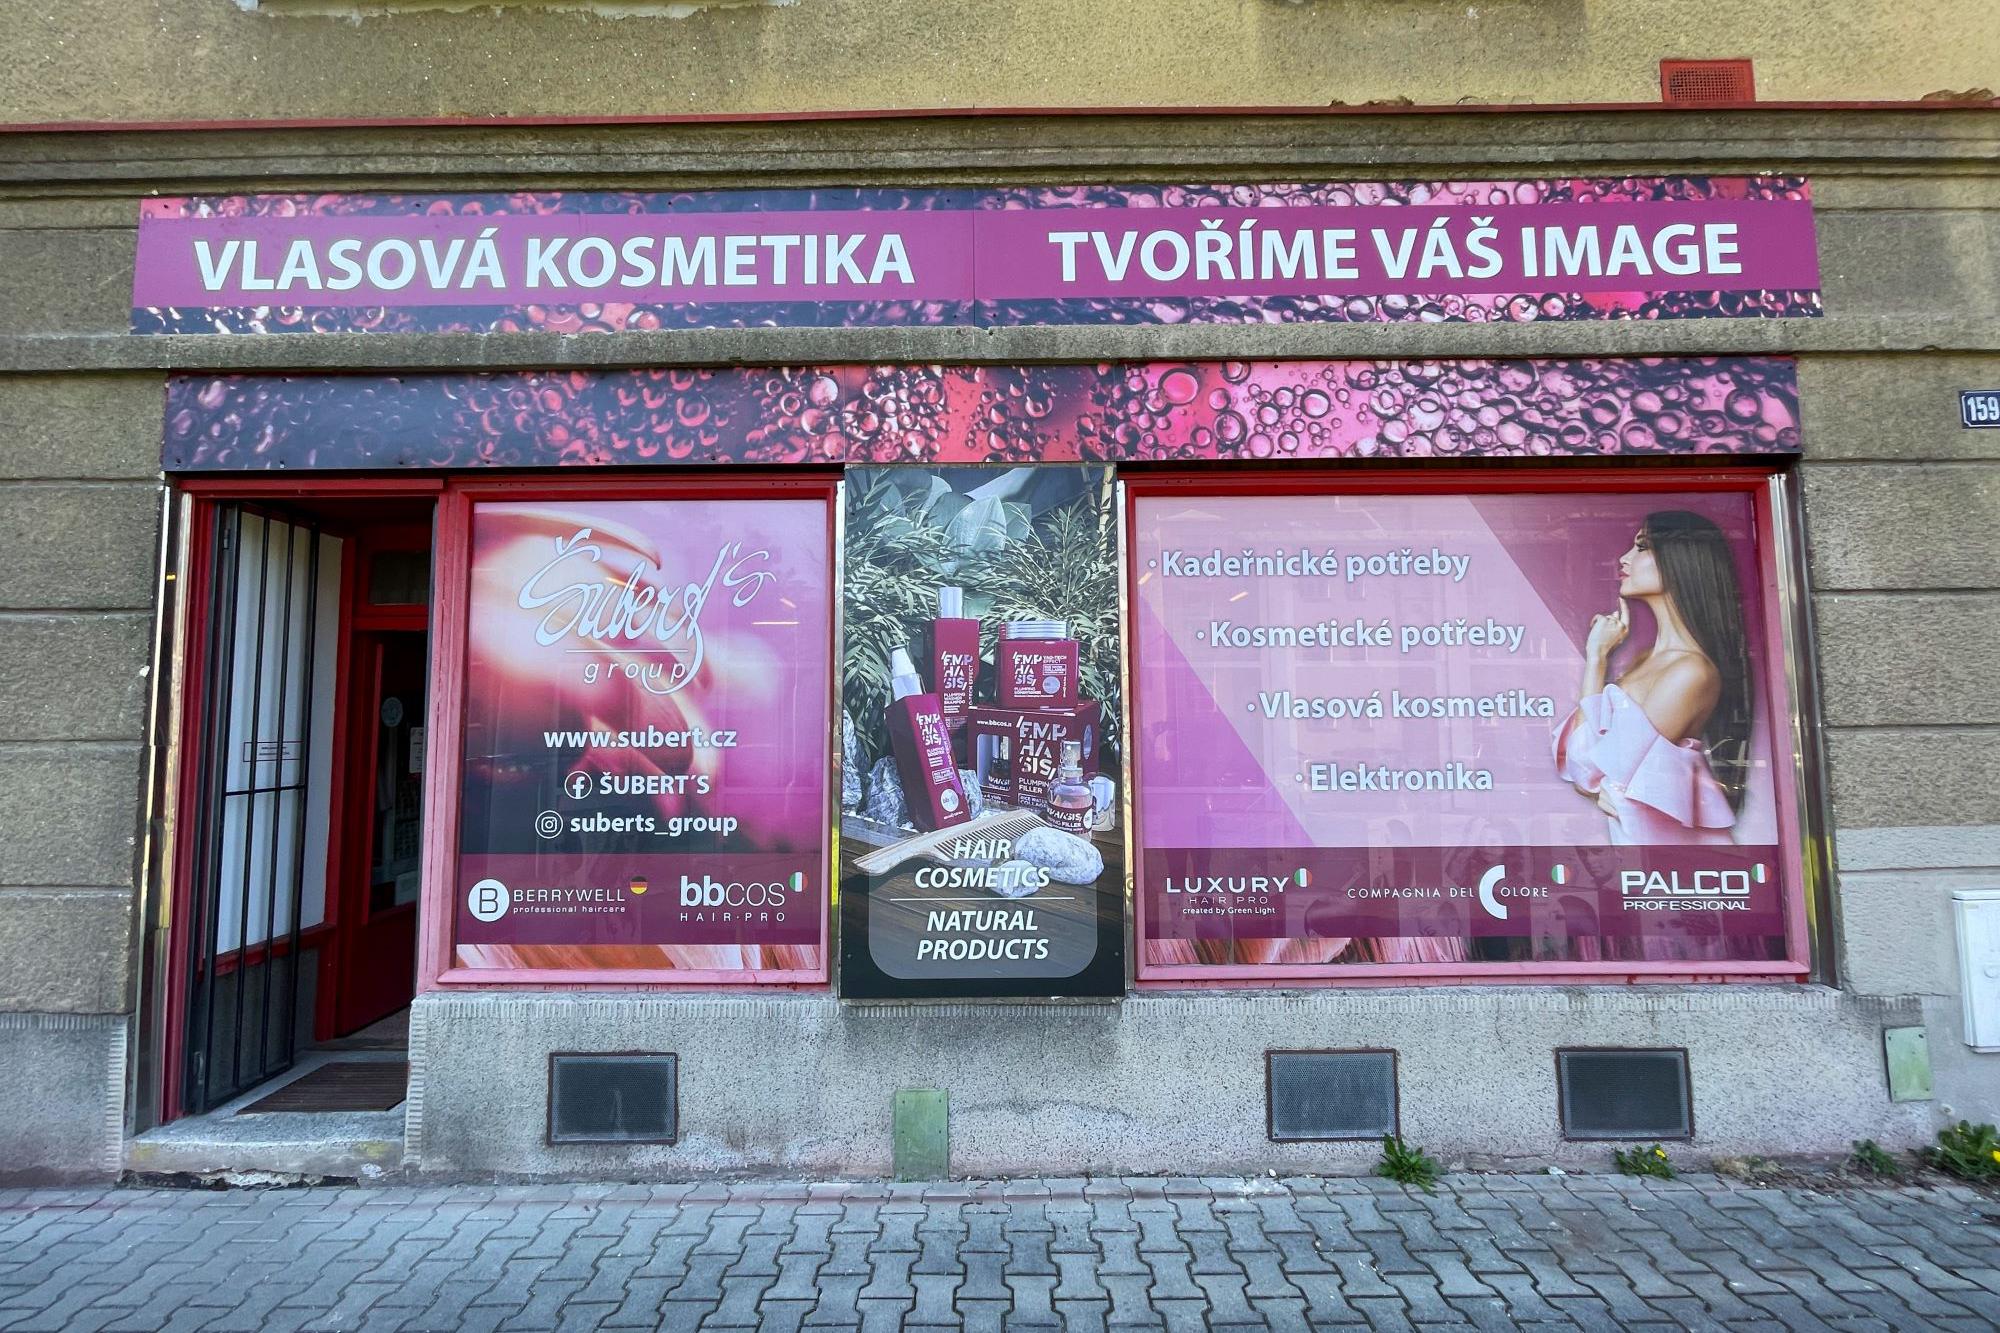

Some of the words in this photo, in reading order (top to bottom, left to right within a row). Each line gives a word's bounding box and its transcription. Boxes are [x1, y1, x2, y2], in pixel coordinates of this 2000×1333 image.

[195, 227, 507, 292] VLASOVÁ
[526, 233, 915, 289] KOSMETIKA
[1048, 218, 1361, 282] TVOŘÍME
[1371, 216, 1504, 279] VÁŠ
[1523, 222, 1743, 277] IMAGE
[1967, 396, 2000, 421] 159
[1162, 549, 1338, 577] Kadeřnické
[1346, 548, 1471, 582] potřeby
[1210, 619, 1393, 648] Kosmetické
[1401, 619, 1526, 654] potřeby
[583, 661, 687, 684] group
[1259, 691, 1385, 718] Vlasová
[1392, 689, 1555, 717] kosmetika
[544, 725, 737, 748] www.subert.cz
[1311, 763, 1494, 791] Elektronika
[570, 812, 738, 837] suberts_group
[953, 839, 1012, 859] HAIR
[914, 867, 1050, 888] COSMETICS
[1166, 876, 1290, 893] LUXURY
[1620, 870, 1751, 895] PALCO
[513, 889, 625, 902] BERRYWELL
[1189, 896, 1227, 905] HAIR
[1236, 896, 1268, 904] PRO
[1347, 887, 1442, 899] COMPAGNIA
[1449, 887, 1475, 898] DEL
[513, 905, 577, 915] professional
[582, 905, 626, 914] haircare
[1182, 906, 1212, 916] created
[1216, 906, 1225, 916] by
[1227, 906, 1253, 915] Green
[1254, 906, 1276, 916] Light
[1623, 900, 1752, 911] PROFESSIONAL
[927, 910, 1038, 932] NATURAL
[916, 938, 1049, 961] PRODUCTS
